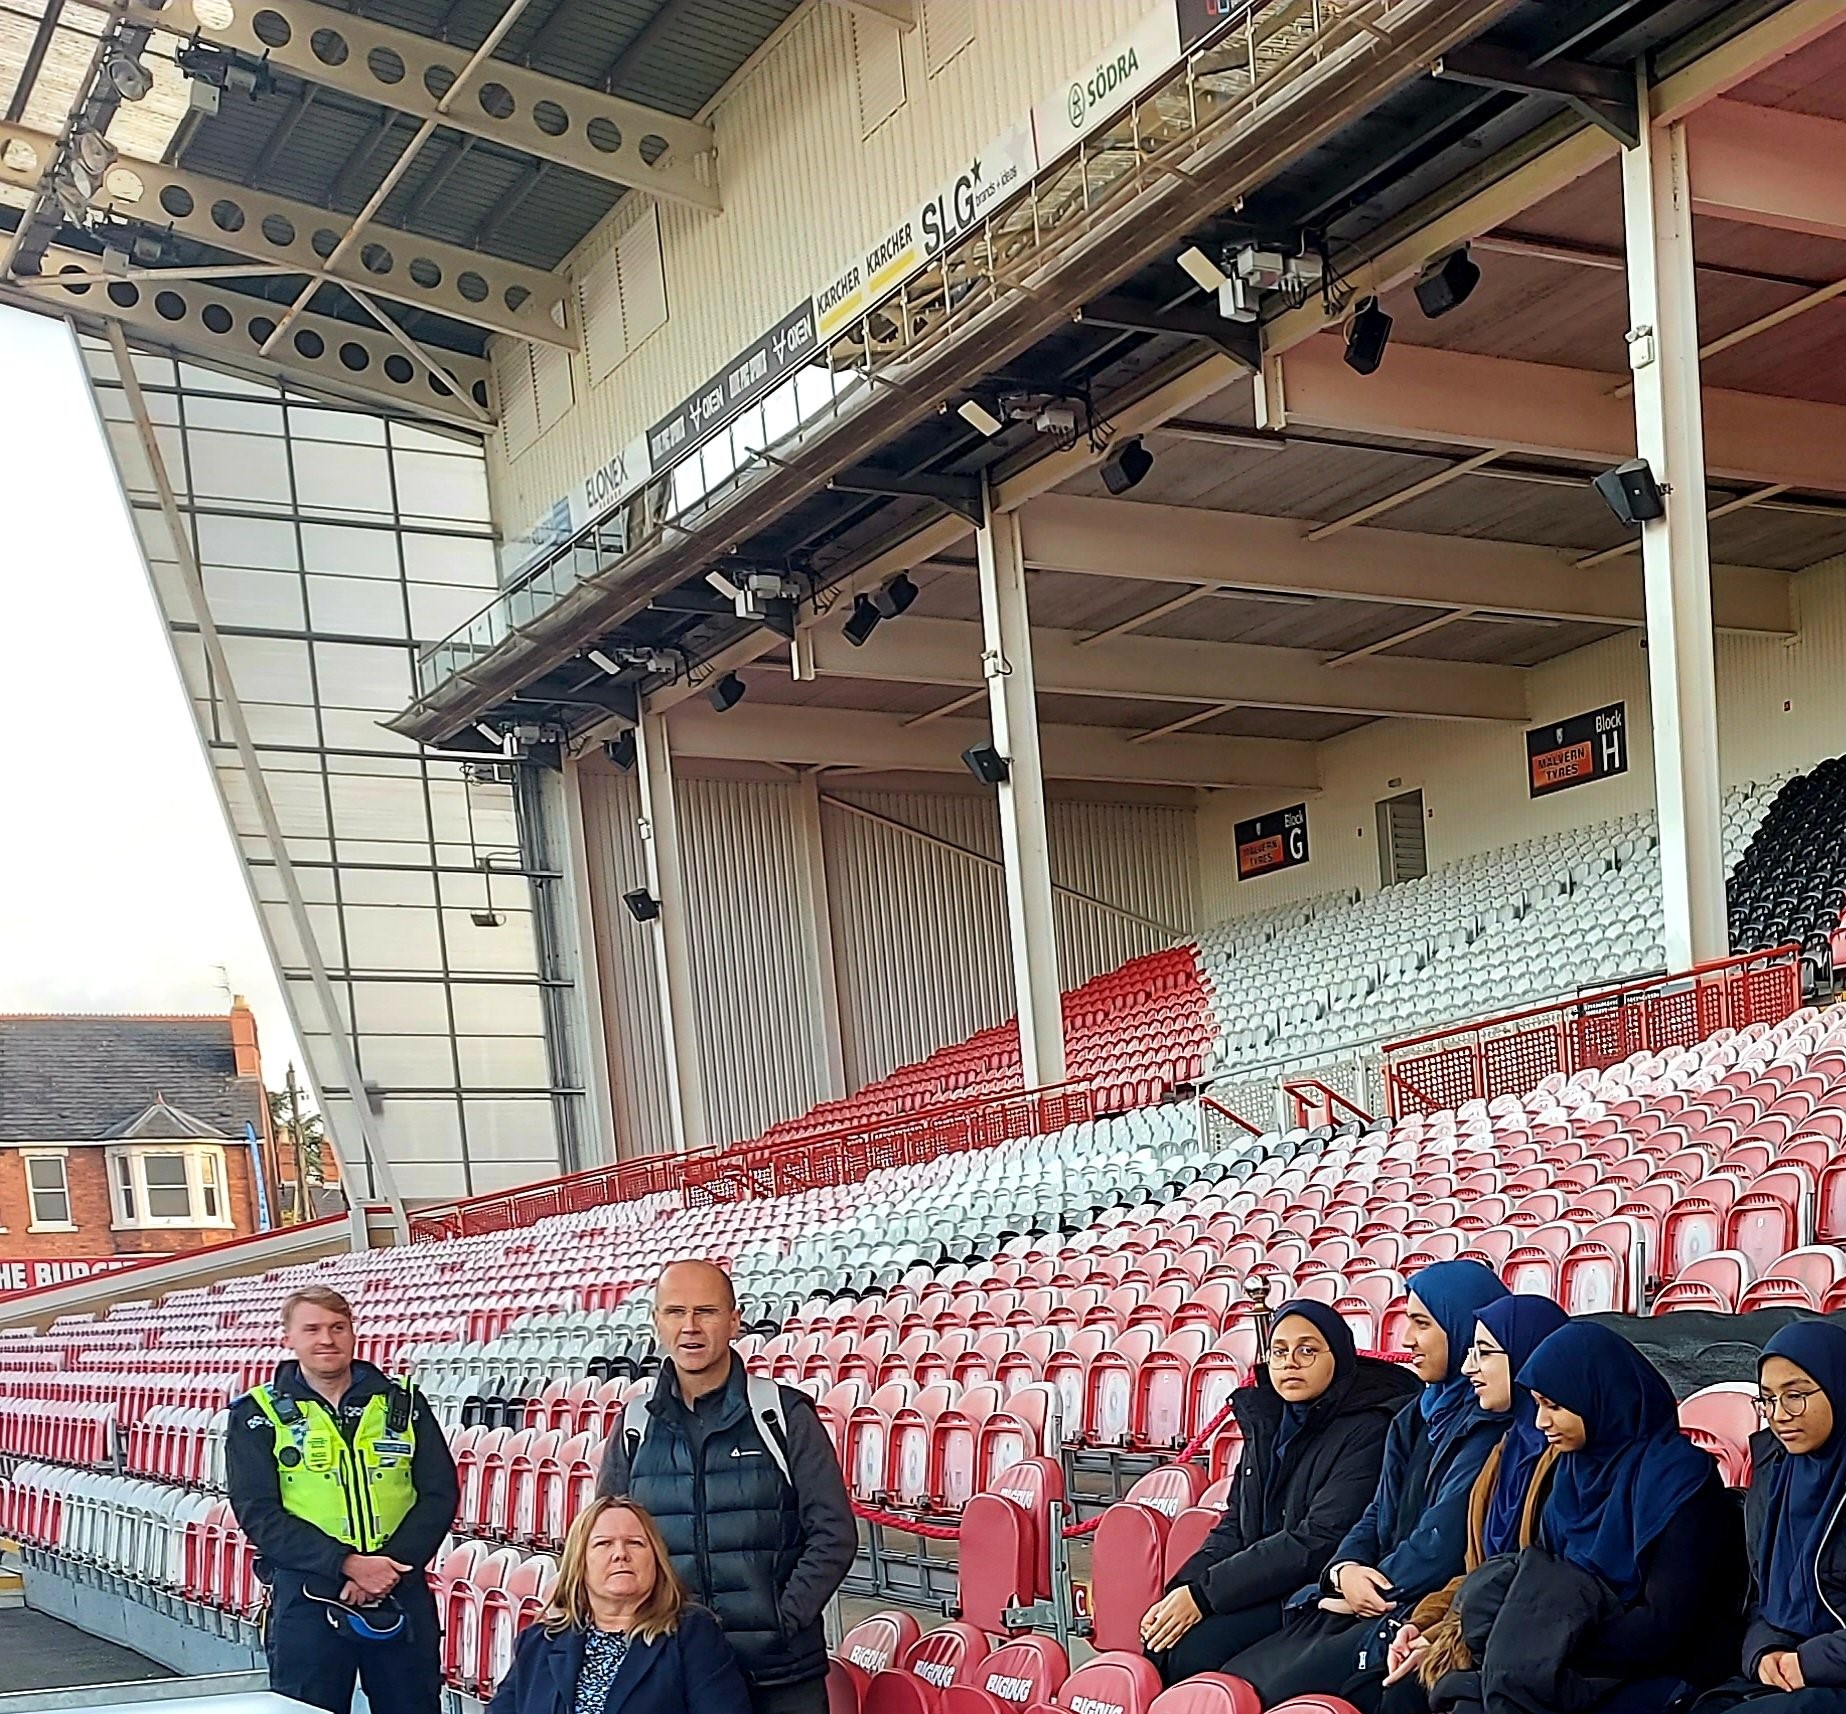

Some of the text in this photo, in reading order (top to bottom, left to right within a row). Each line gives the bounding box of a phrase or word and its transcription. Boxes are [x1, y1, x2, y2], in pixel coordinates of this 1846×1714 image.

[1087, 48, 1139, 107] SÖDRA
[922, 175, 977, 257] SLG
[585, 450, 628, 508] ELONEX
[1595, 709, 1622, 733] Block
[1538, 746, 1585, 769] MALVERN
[1601, 730, 1620, 772] H
[1546, 763, 1579, 781] TYRES
[1284, 809, 1304, 828] Block
[1289, 827, 1303, 859] G
[1076, 1590, 1086, 1616] C
